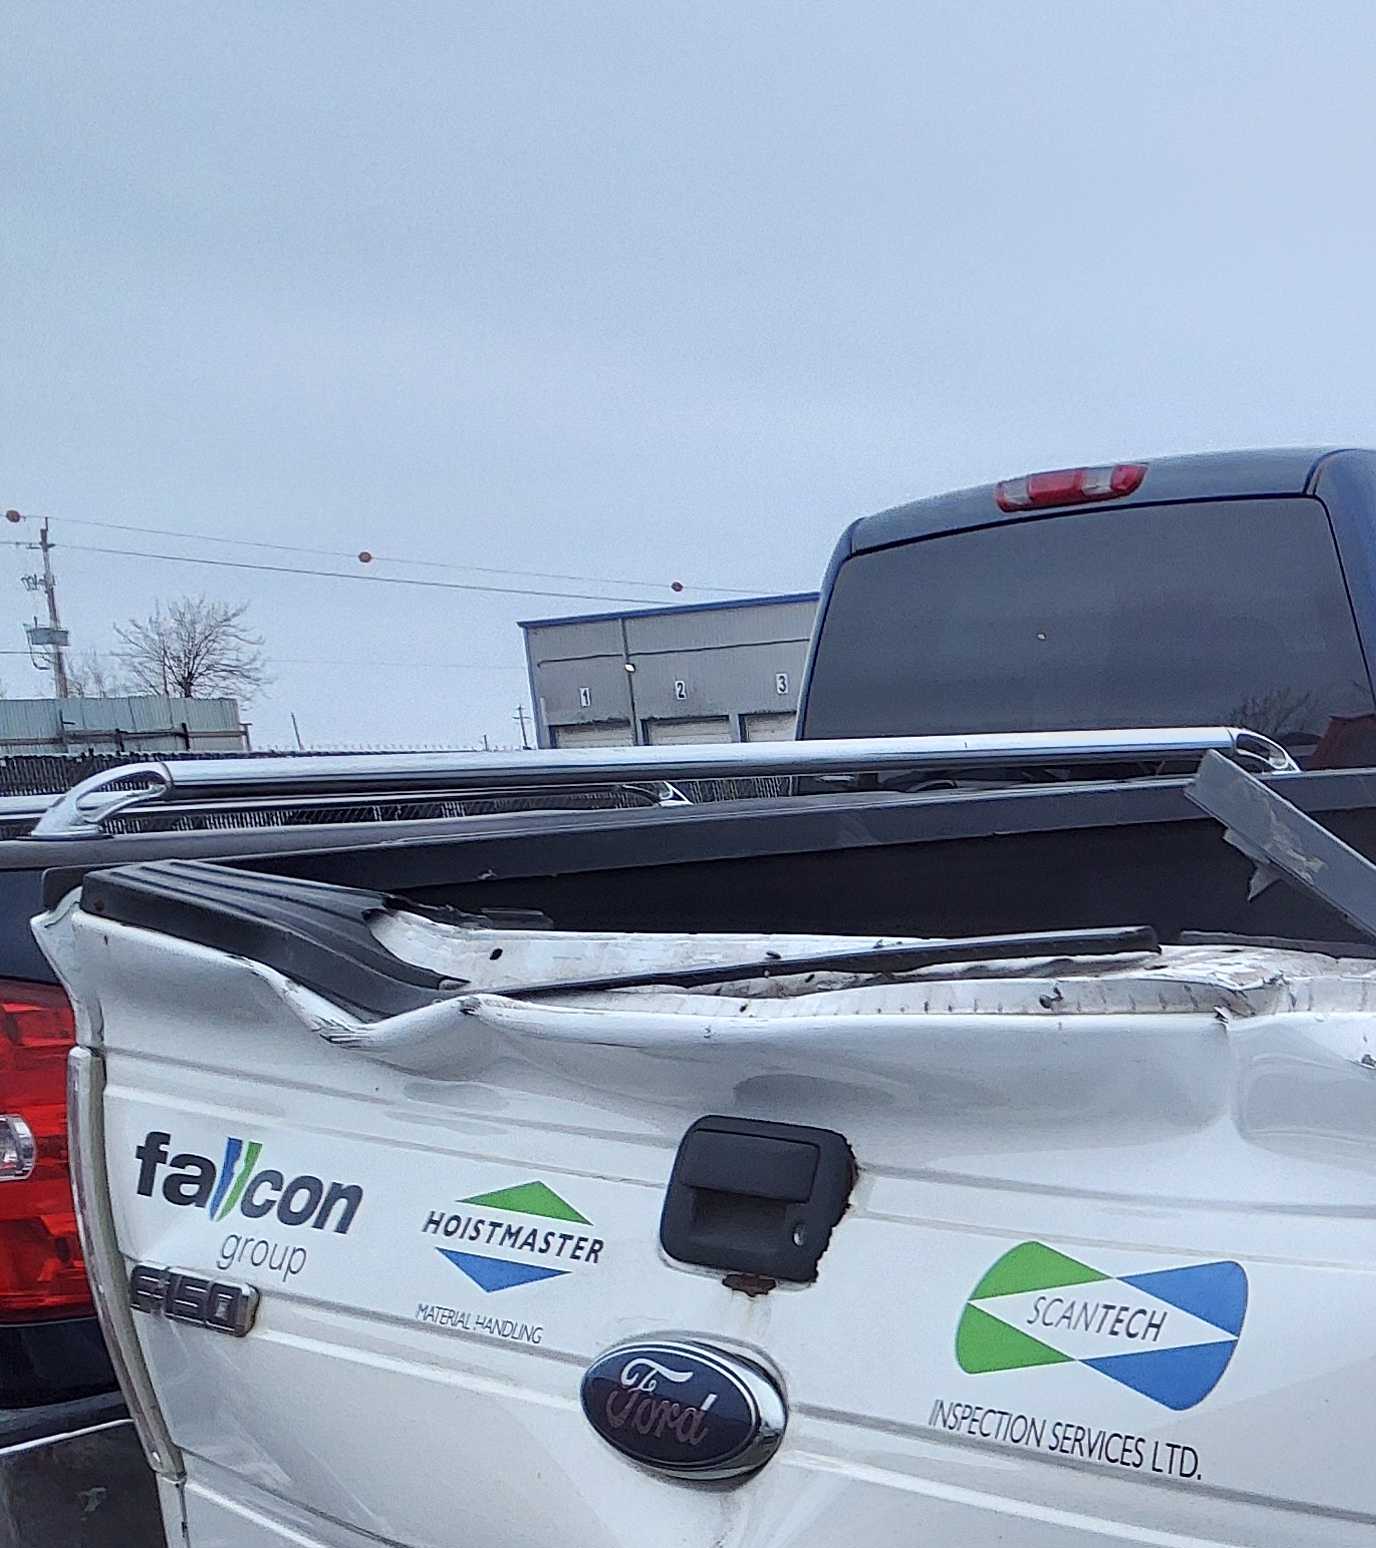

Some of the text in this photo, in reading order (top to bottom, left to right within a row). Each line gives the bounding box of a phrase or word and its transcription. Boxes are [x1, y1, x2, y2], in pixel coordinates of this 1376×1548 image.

[216, 1233, 307, 1282] group
[422, 1211, 605, 1263] HOISTMASTER
[416, 1303, 544, 1344] MATERIAL HANDLING
[1026, 1296, 1168, 1342] SCANTECH
[606, 1357, 718, 1446] Ford
[929, 1399, 1202, 1480] INSPECTION SERVICES LTD.
